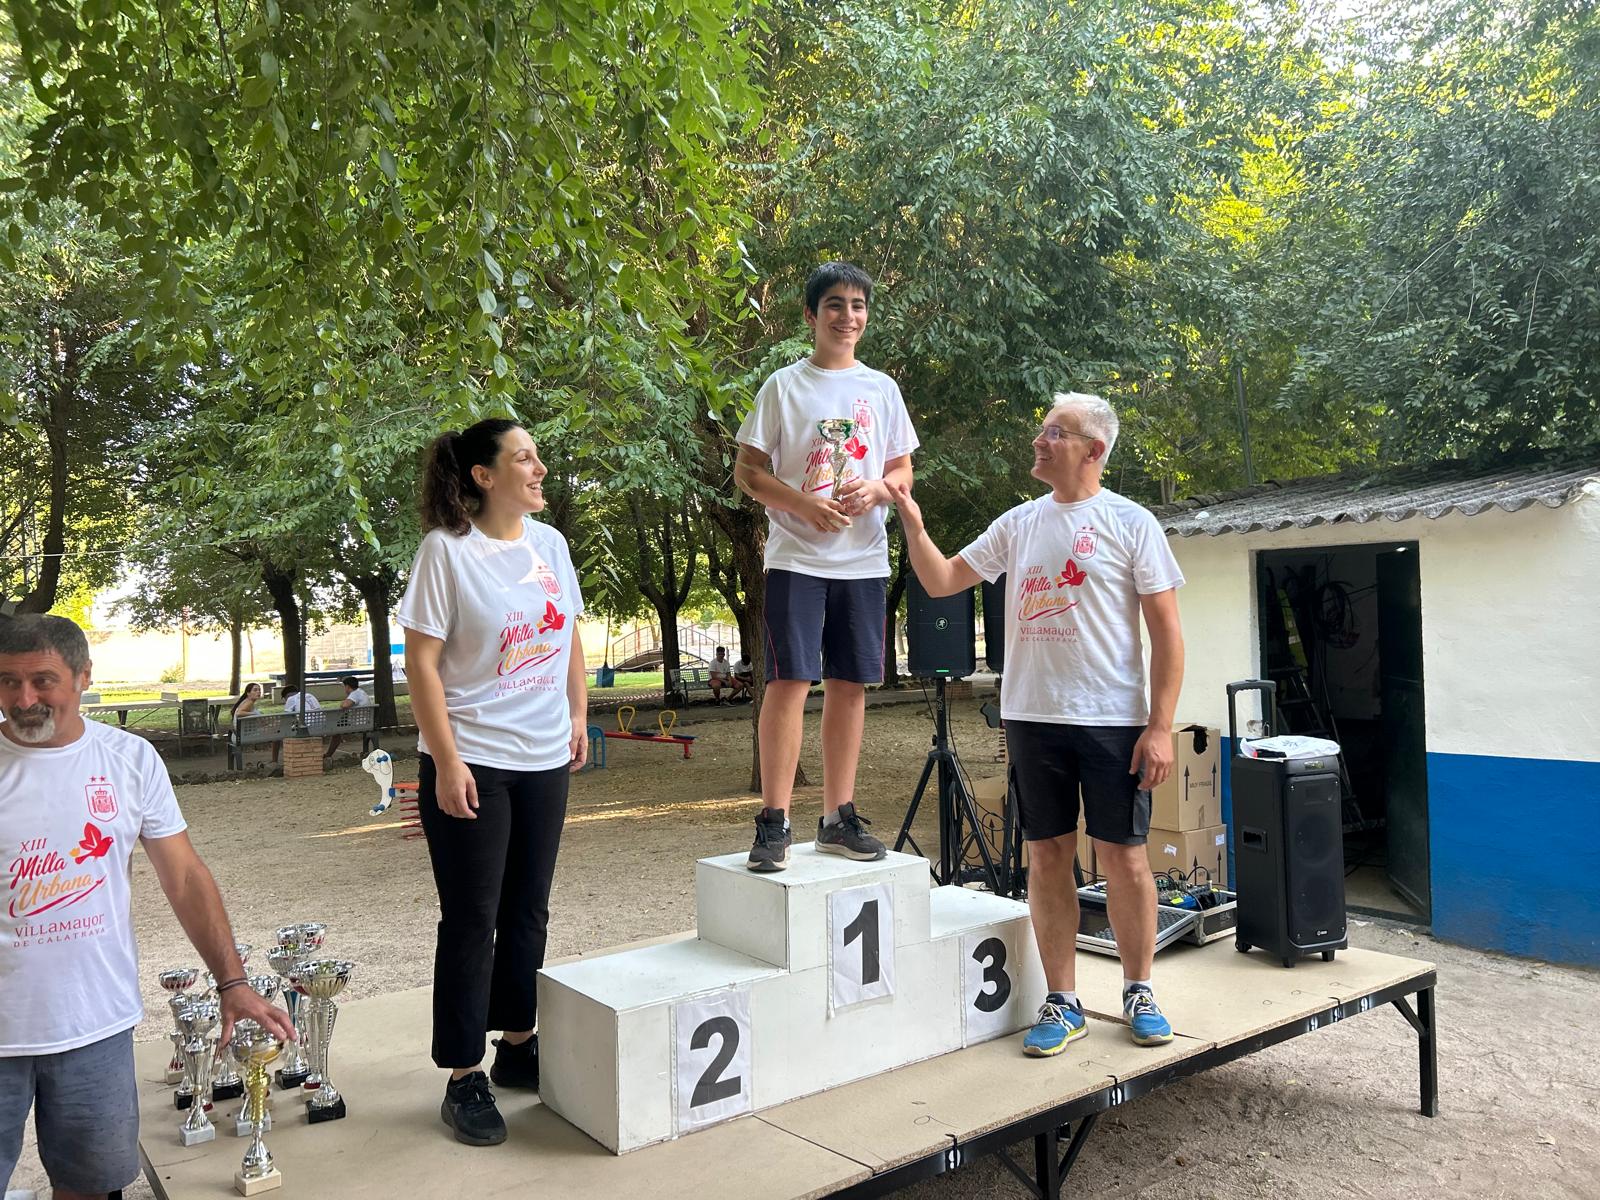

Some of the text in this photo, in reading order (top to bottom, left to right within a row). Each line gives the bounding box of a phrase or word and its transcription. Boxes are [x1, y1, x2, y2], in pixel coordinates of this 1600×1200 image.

[806, 447, 832, 474] Mill
[1027, 566, 1042, 575] XIII
[1021, 576, 1053, 600] Milla
[505, 611, 523, 624] XIII
[1023, 593, 1068, 617] Urbana
[500, 623, 535, 653] Milla
[504, 642, 552, 671] Urbana
[20, 838, 47, 854] XIII
[9, 851, 68, 890] Milla
[18, 874, 93, 912] Urbana
[13, 927, 105, 949] DE CALATRAVA
[843, 898, 880, 986] 1
[972, 937, 1012, 1013] 3
[690, 1015, 741, 1109] 2
